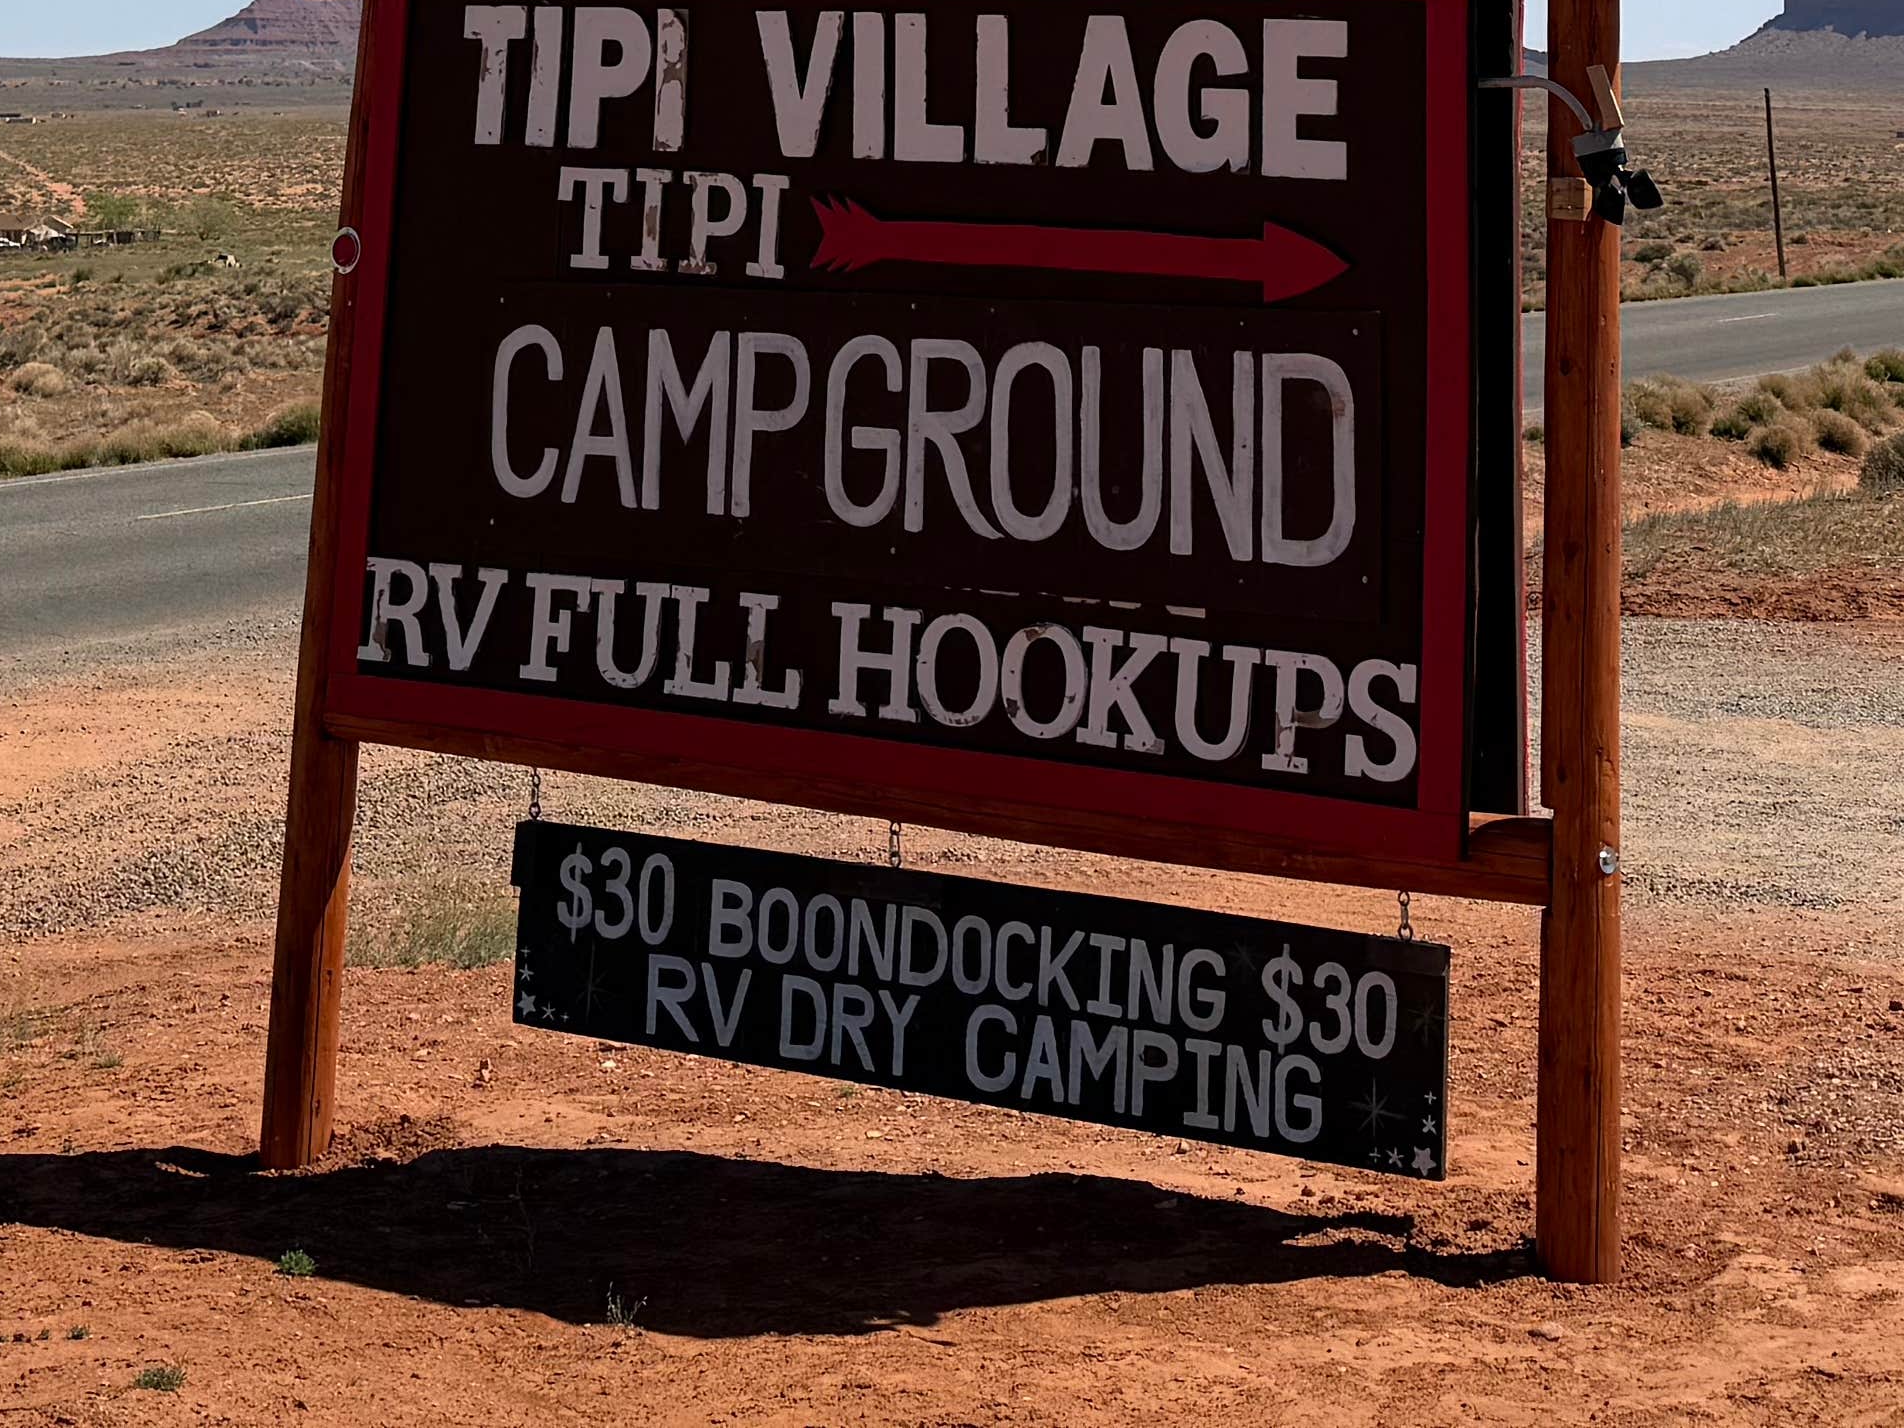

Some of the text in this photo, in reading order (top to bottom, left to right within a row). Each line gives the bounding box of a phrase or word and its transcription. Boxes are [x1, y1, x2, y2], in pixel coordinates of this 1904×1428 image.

[462, 5, 1348, 180] TIPI VILLAGE
[557, 165, 789, 280] TIPI
[493, 324, 1357, 565] CAMPGROUND
[356, 556, 1418, 782] RV FULL HOOKUPS
[556, 843, 1398, 1059] $30 BOONDOCKING $30
[646, 956, 1324, 1144] RV DRY CAMPING
